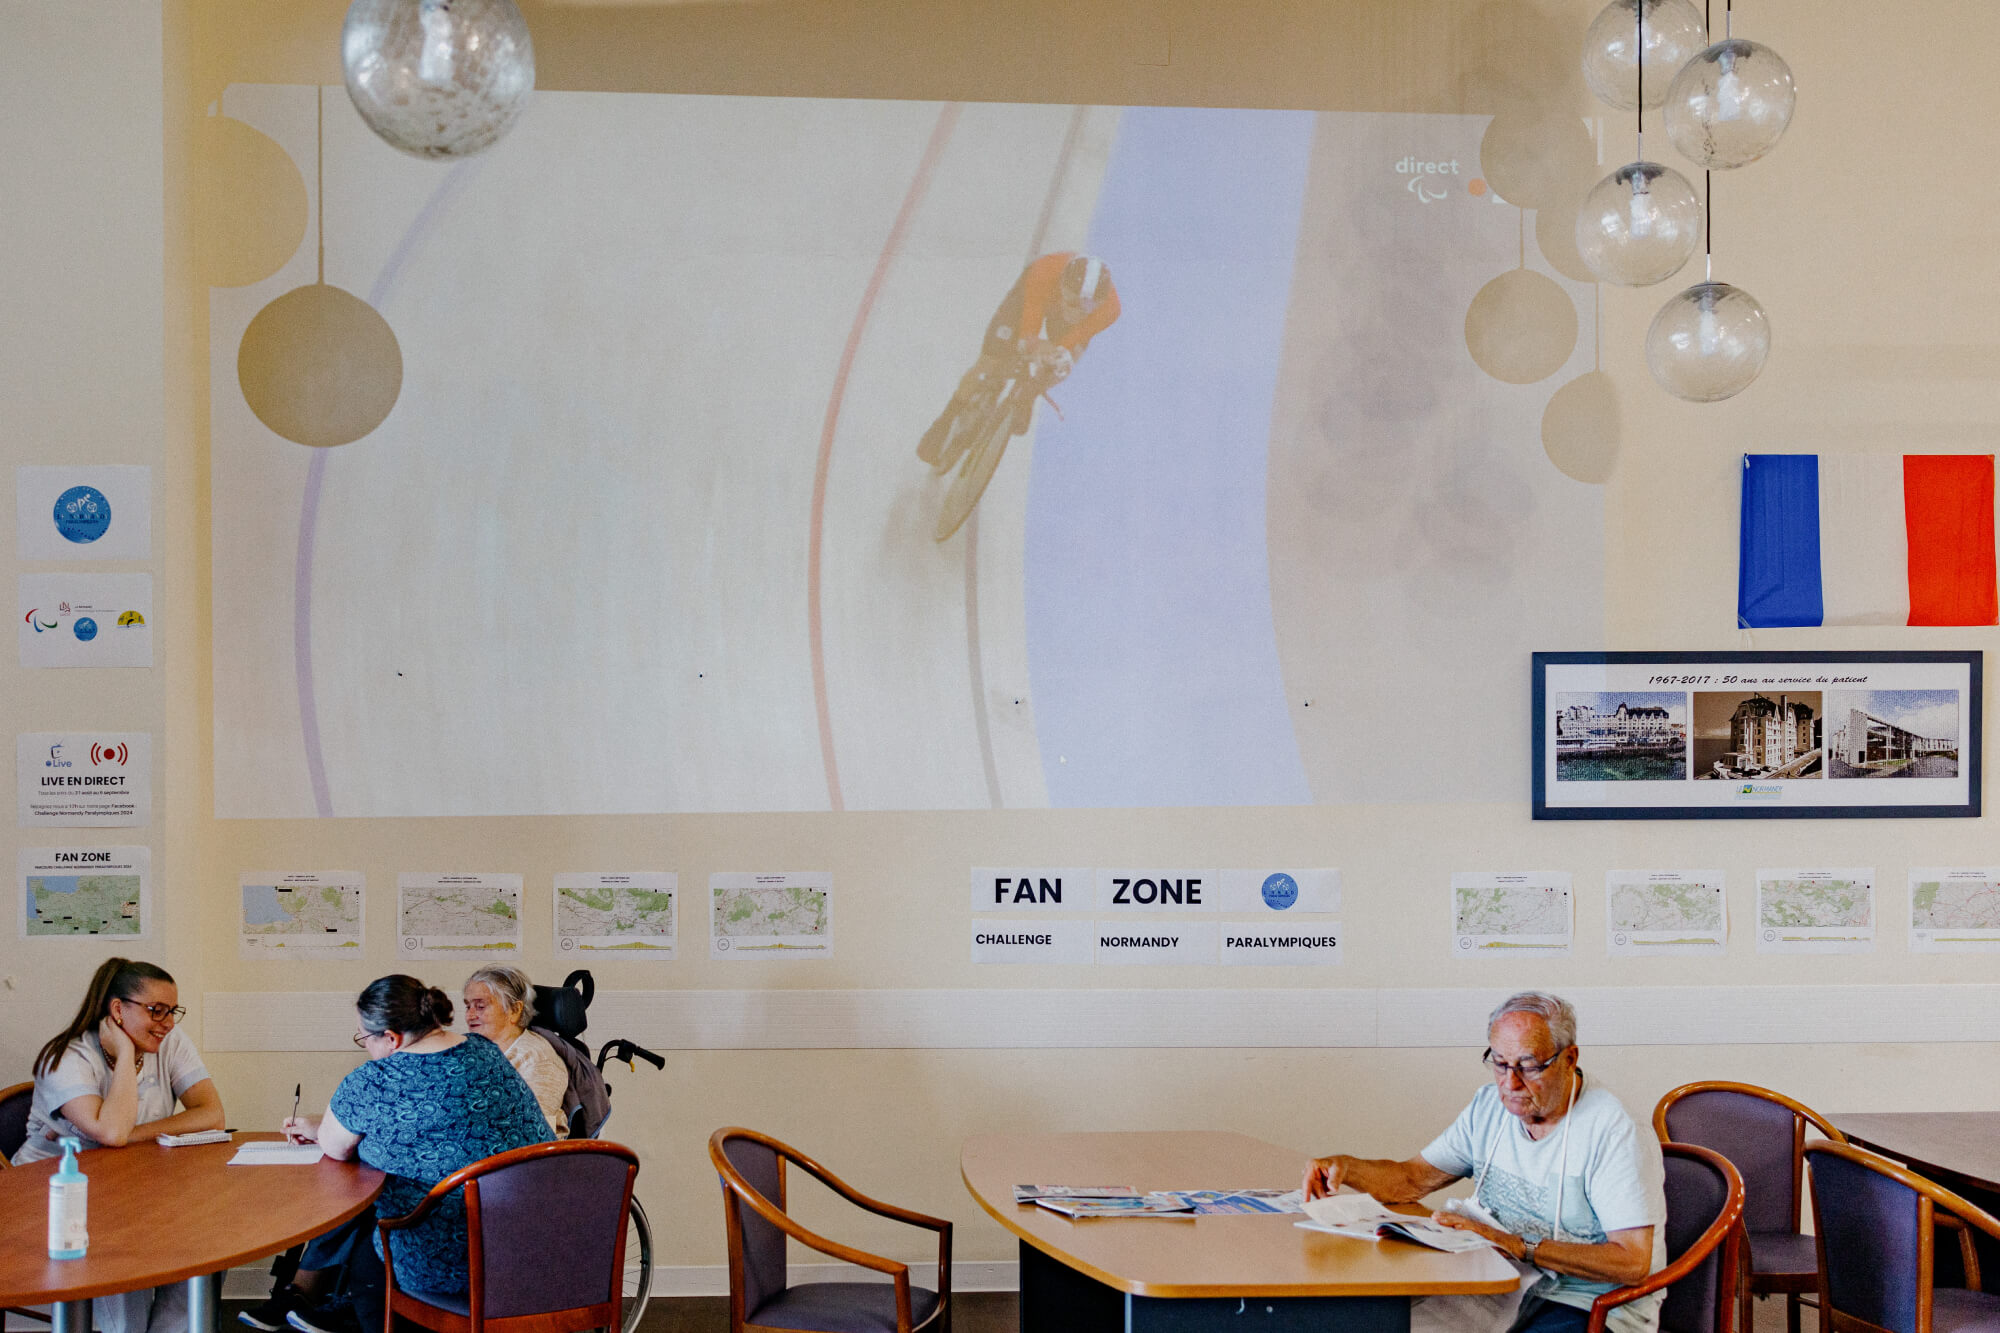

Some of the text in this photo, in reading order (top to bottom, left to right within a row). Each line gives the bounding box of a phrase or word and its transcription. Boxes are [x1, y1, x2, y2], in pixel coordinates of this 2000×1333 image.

[1395, 156, 1459, 175] direct
[1648, 675, 1711, 685] 1967-2017
[1722, 675, 1738, 684] 50
[1778, 676, 1812, 684] service
[1815, 675, 1828, 683] du
[1831, 675, 1868, 685] patient
[52, 759, 72, 768] Live
[41, 776, 126, 786] LIVE EN DIRECT
[55, 852, 111, 862] FAN ZONE
[995, 878, 1202, 905] FAN ZONE
[975, 935, 1336, 950] CHALLENGE NORMANDY PARALYMPIQUES
